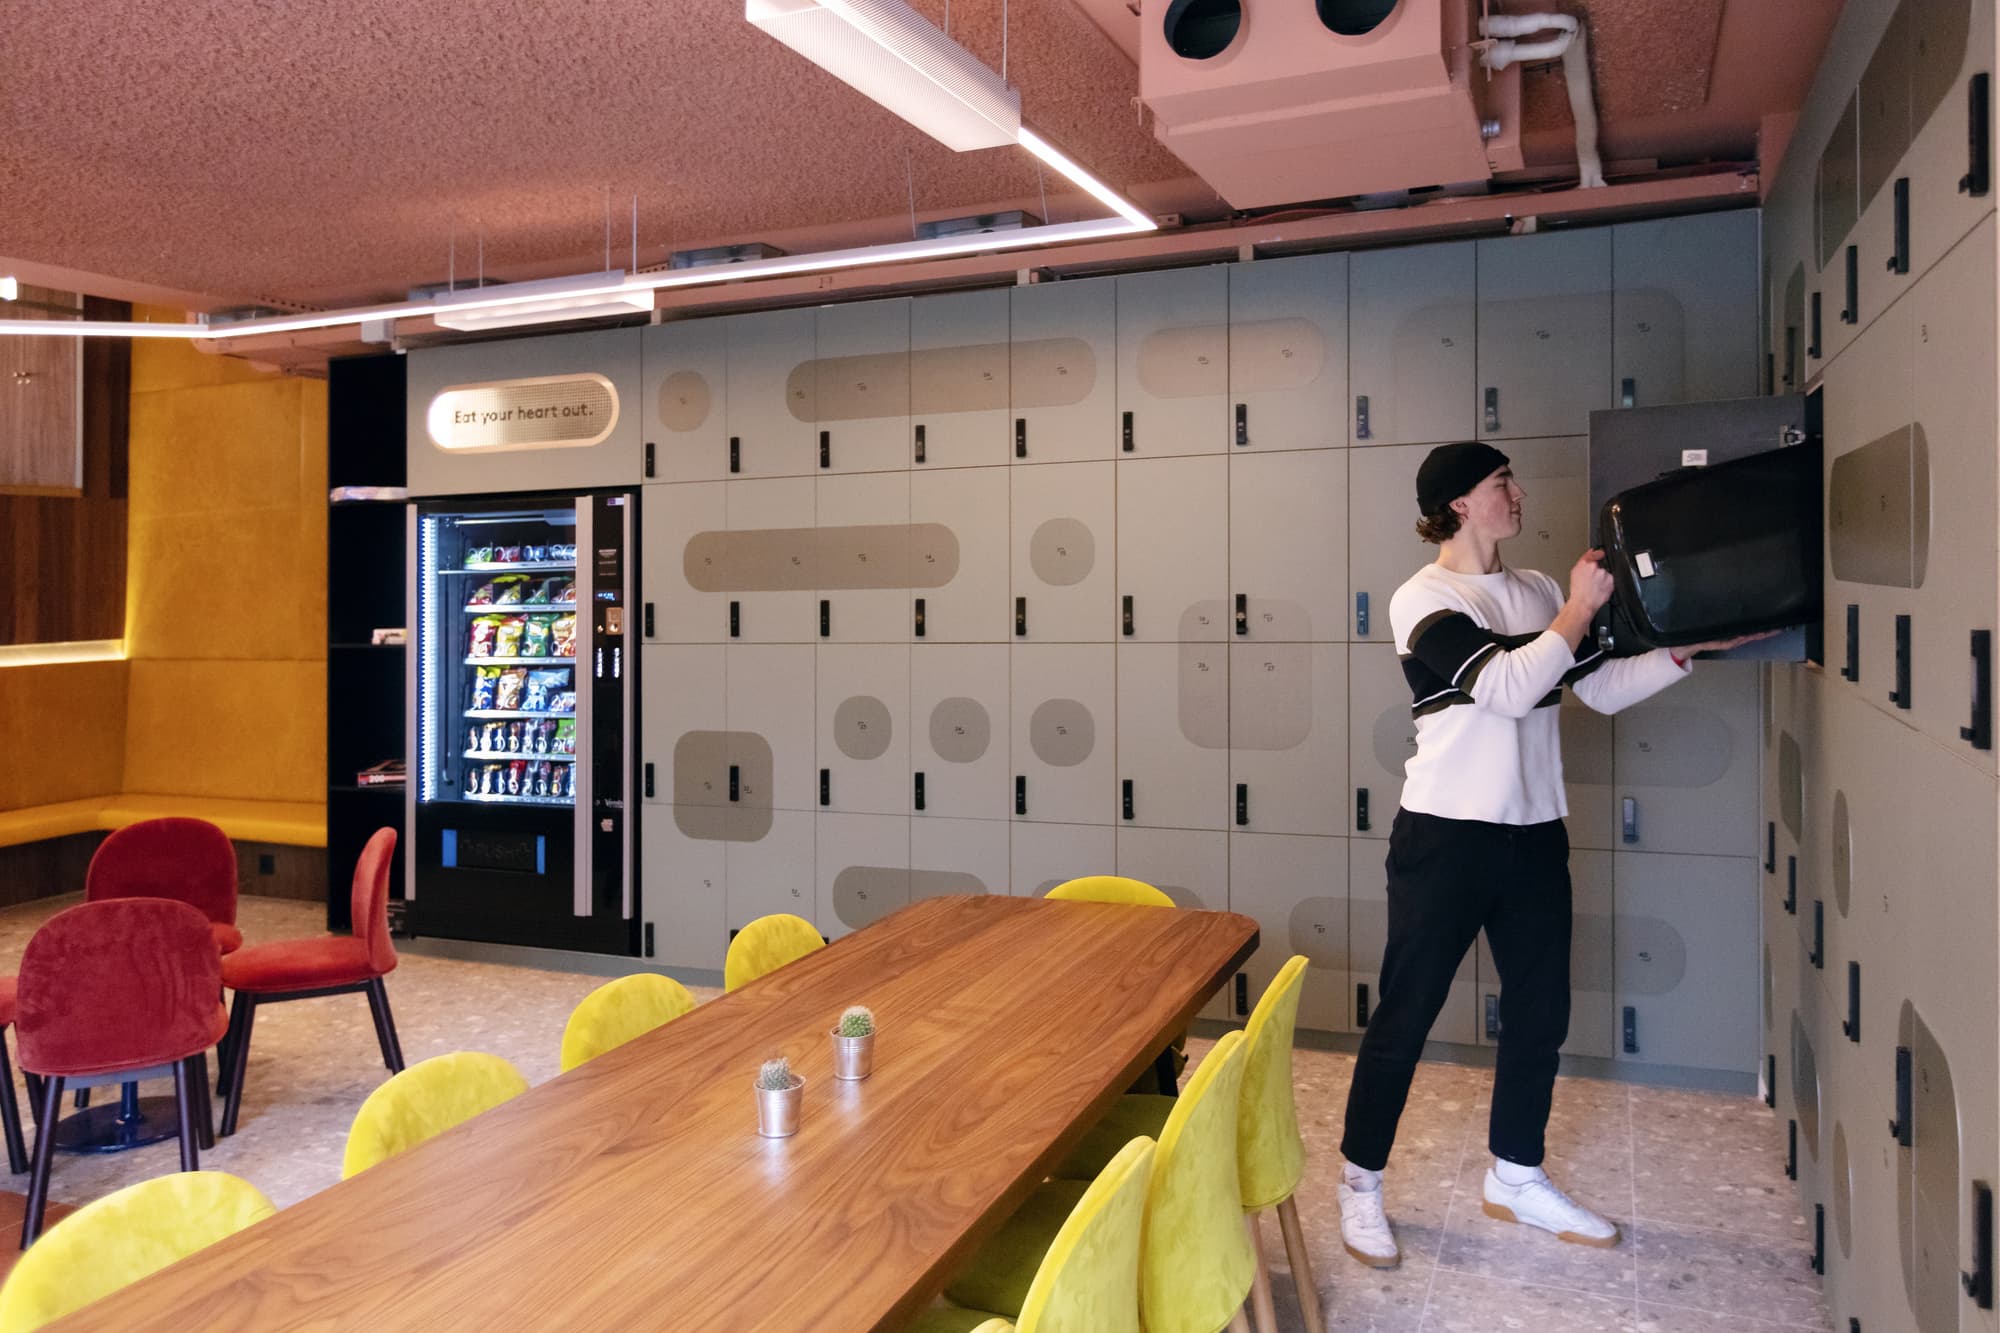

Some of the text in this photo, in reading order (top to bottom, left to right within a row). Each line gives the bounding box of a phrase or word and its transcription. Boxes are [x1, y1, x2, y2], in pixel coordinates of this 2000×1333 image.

[455, 404, 593, 425] Eat your heart out.
